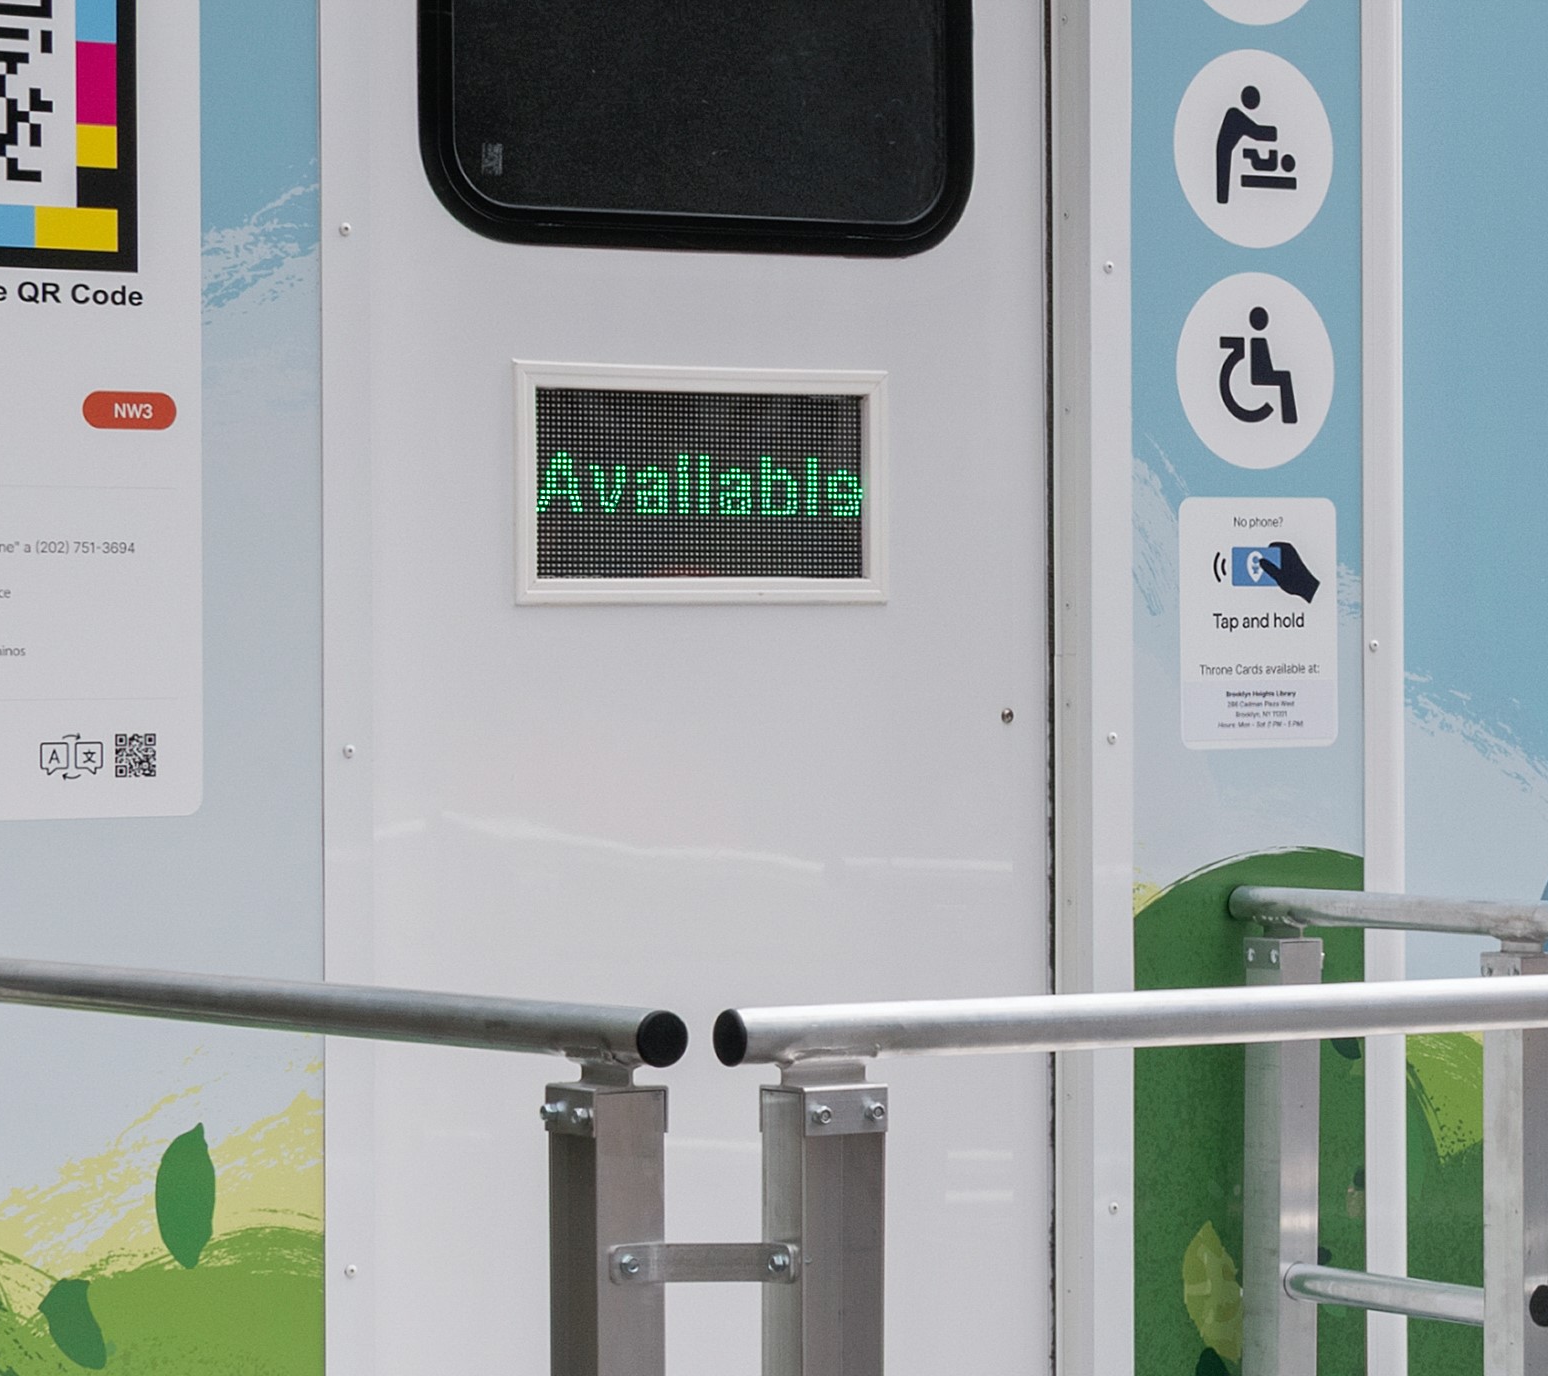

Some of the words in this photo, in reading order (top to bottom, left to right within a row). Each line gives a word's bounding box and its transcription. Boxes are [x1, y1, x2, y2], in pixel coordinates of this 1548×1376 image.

[17, 280, 61, 305] QR
[70, 283, 144, 307] Code
[113, 402, 154, 420] NW3
[536, 451, 864, 517] Available
[1232, 516, 1248, 528] No
[1249, 516, 1285, 529] phone?
[23, 543, 32, 553] a
[35, 540, 70, 555] (202)
[73, 540, 136, 554] 751-3694
[1212, 612, 1240, 633] Tap
[1242, 612, 1270, 629] and
[1274, 612, 1305, 629] hold
[1199, 664, 1233, 676] Throne
[1235, 663, 1263, 675] Cards
[1265, 662, 1306, 675] available
[1308, 663, 1320, 675] at:
